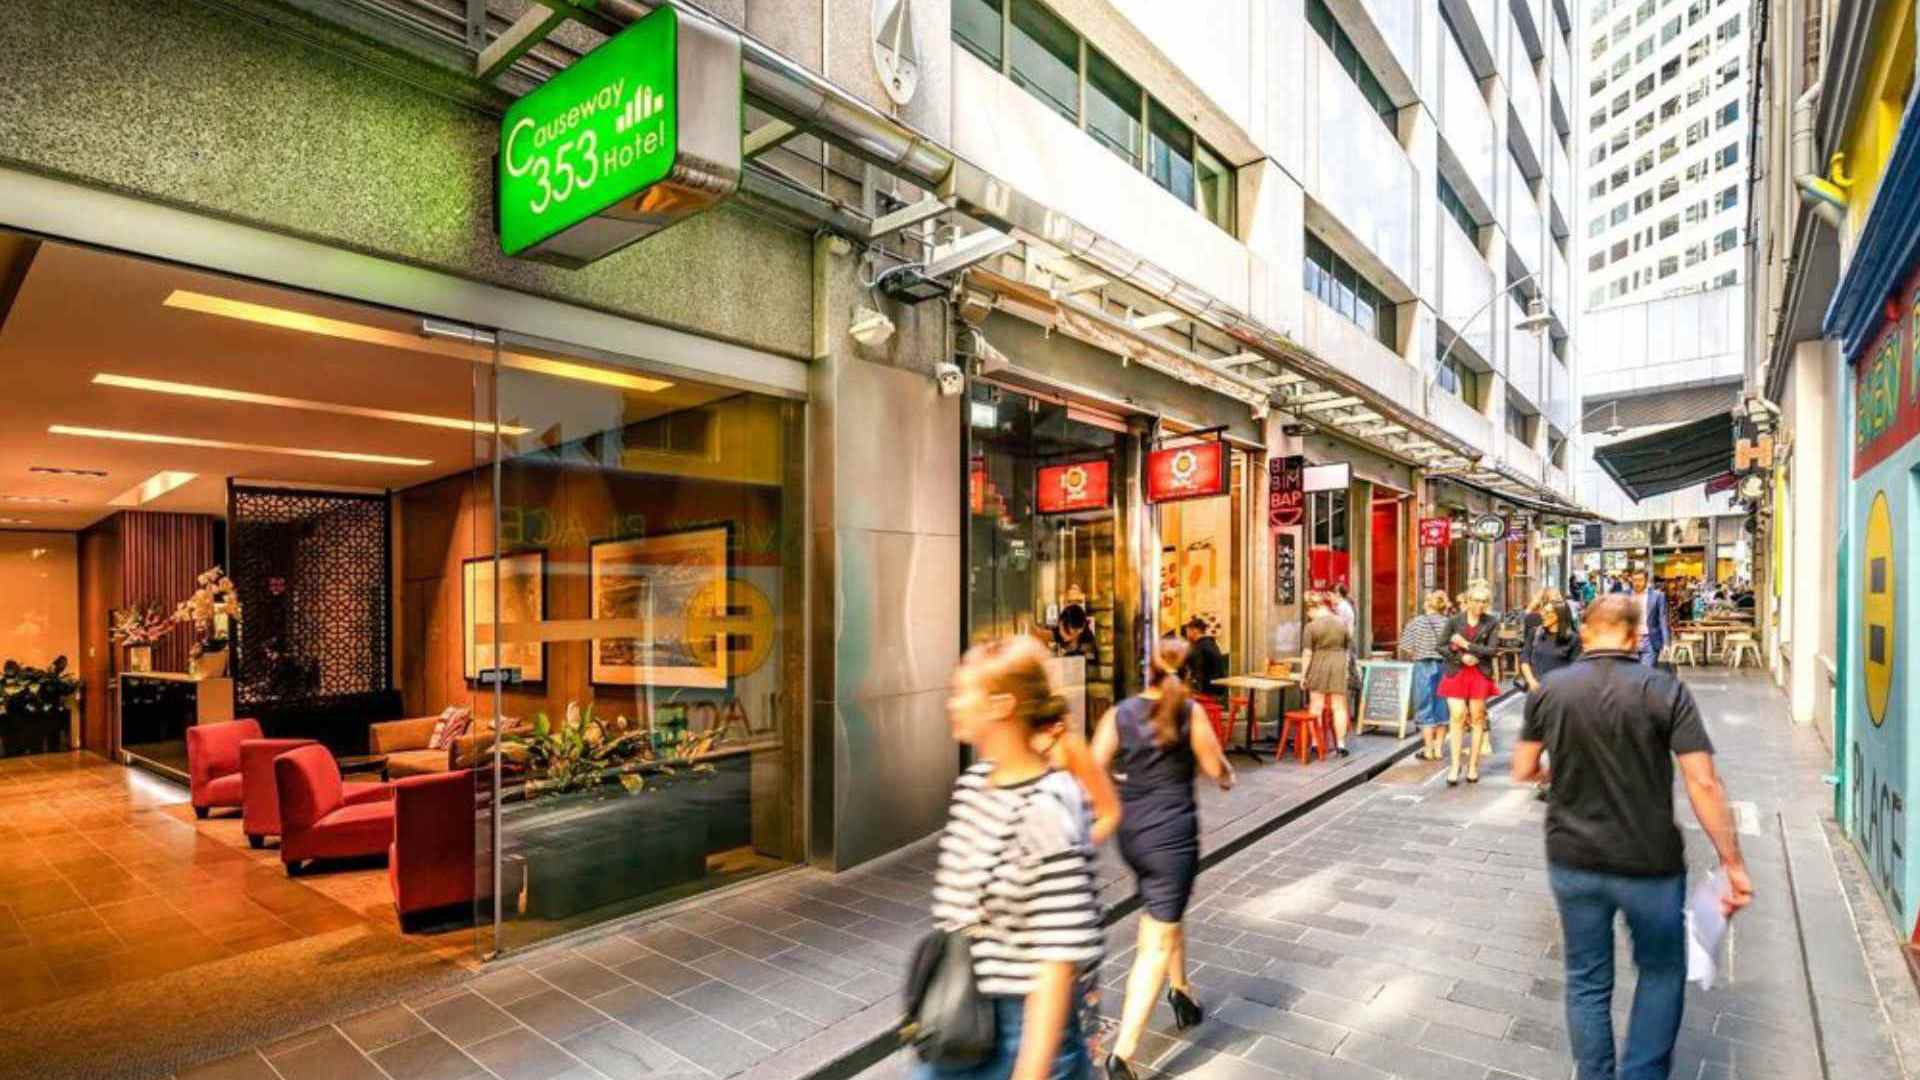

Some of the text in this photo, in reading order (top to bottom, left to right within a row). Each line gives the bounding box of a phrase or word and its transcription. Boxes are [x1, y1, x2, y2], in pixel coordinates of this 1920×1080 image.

[506, 78, 624, 177] Causeway
[530, 120, 665, 213] 353 Hotel
[1271, 474, 1302, 491] BIM
[1735, 433, 1773, 470] H
[1271, 490, 1303, 509] BAP
[1852, 741, 1904, 916] PLACE
